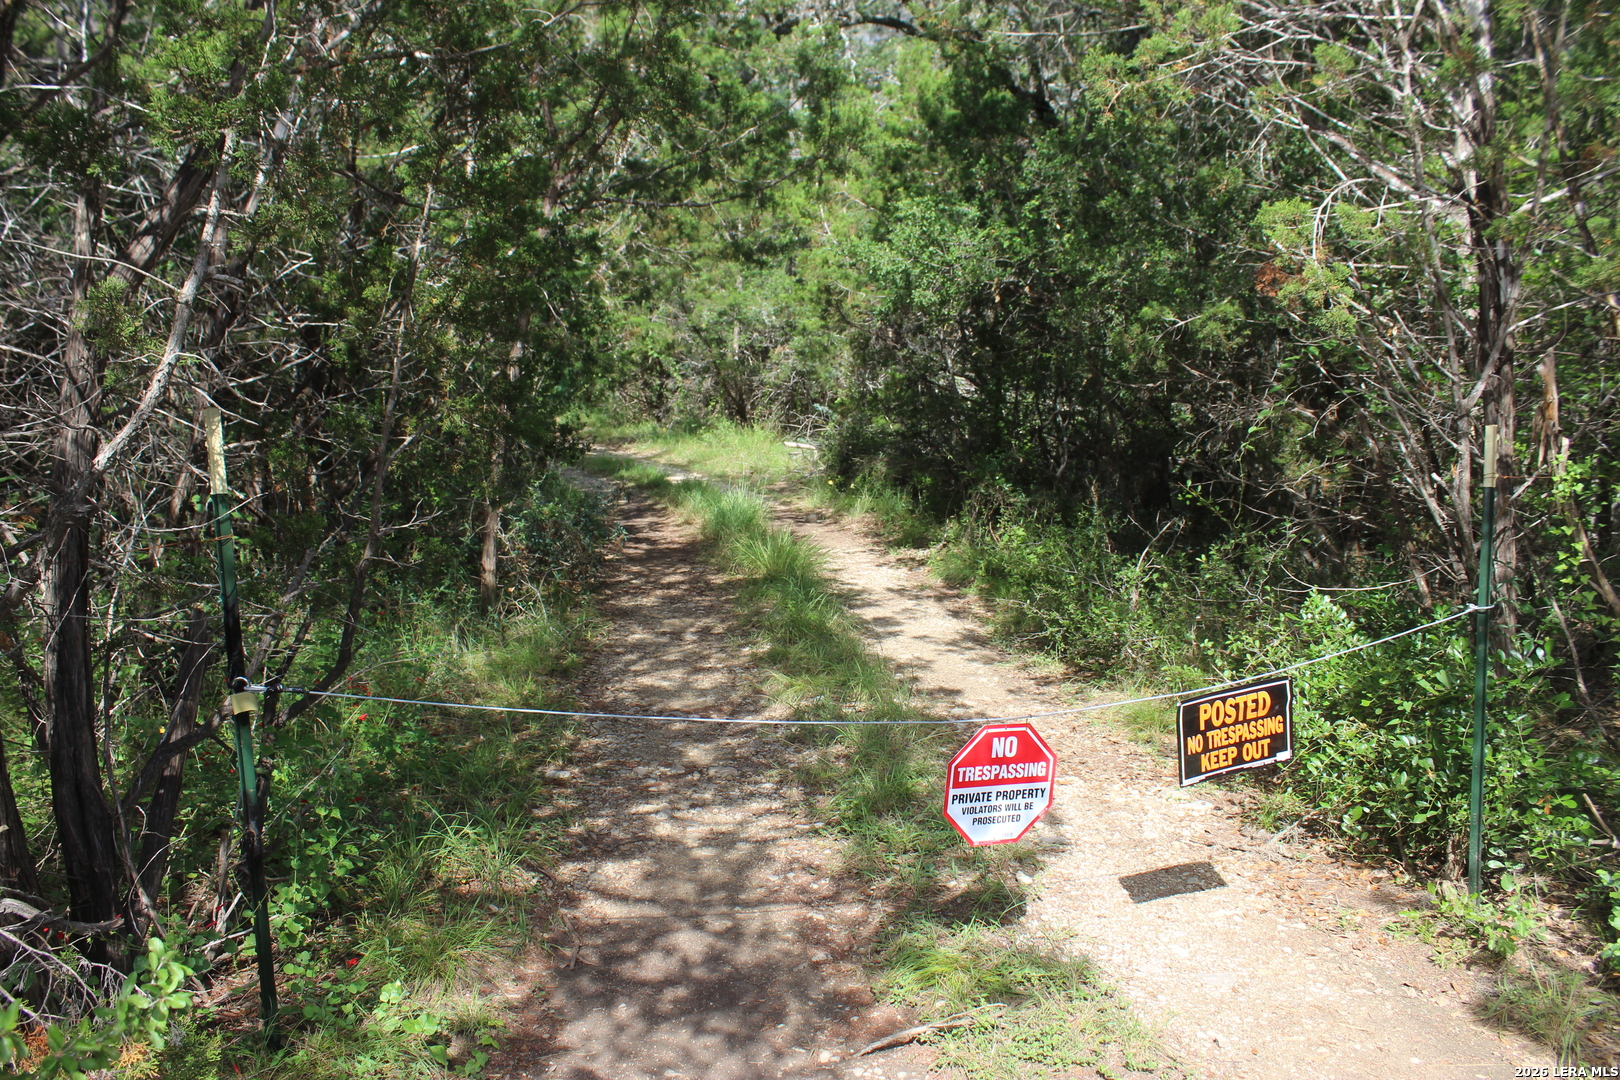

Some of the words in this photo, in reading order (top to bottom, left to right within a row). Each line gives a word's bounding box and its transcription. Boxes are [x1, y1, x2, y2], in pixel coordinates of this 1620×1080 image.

[1198, 690, 1271, 731] POSTED
[1187, 734, 1204, 756] NO
[1206, 715, 1284, 750] TRESPASSING
[991, 736, 1018, 758] NO
[1200, 746, 1238, 773] KEEP
[1242, 738, 1271, 762] OUT
[957, 761, 1047, 783] TRESPASSING
[951, 791, 993, 805] PRIVATE
[995, 787, 1047, 802] PROPERTY
[961, 803, 1003, 815] VIOLATORS
[1004, 802, 1022, 812] WILL
[1024, 801, 1034, 811] BE
[972, 813, 1021, 826] PROSECUTED
